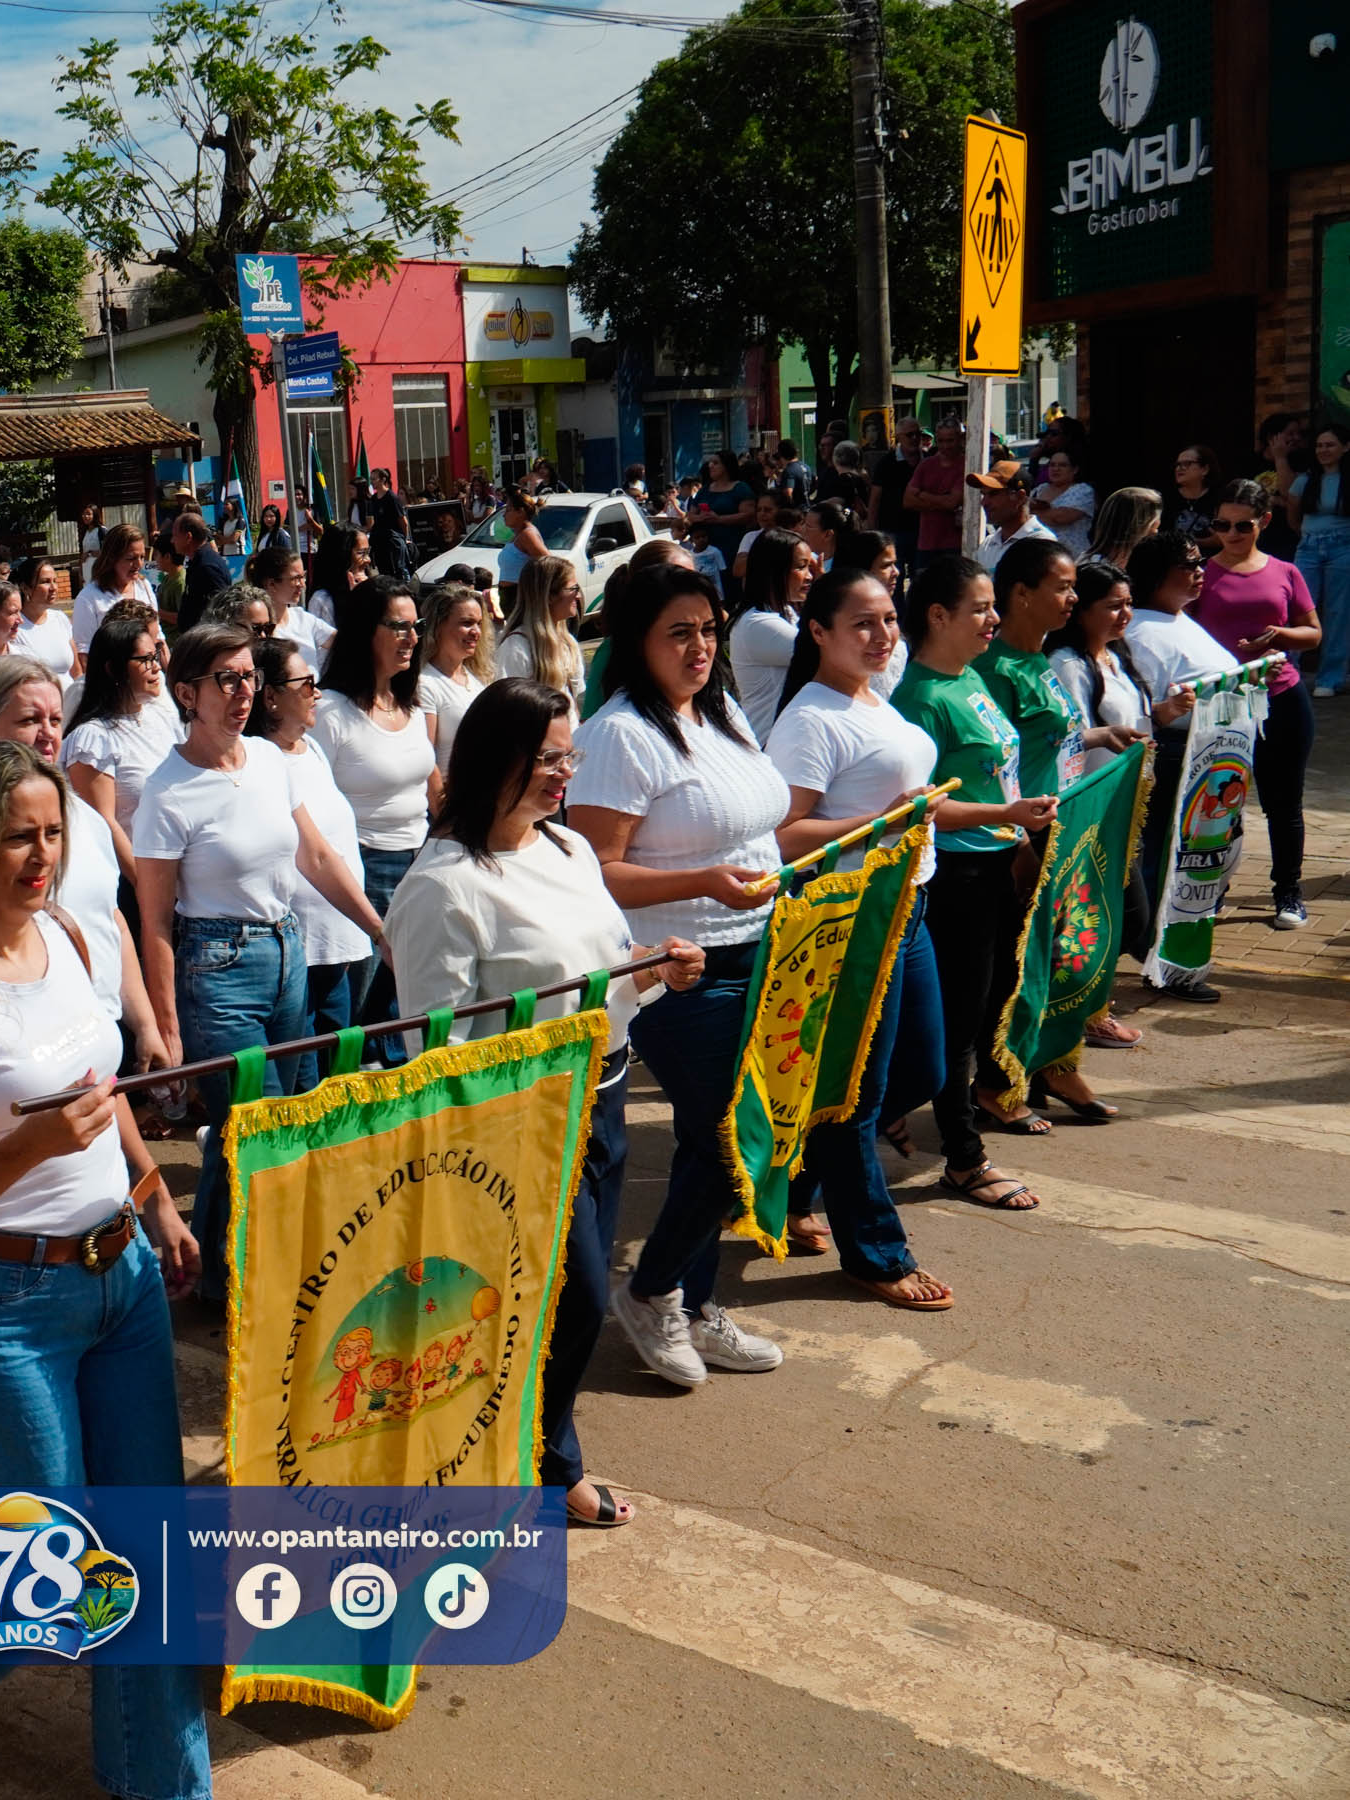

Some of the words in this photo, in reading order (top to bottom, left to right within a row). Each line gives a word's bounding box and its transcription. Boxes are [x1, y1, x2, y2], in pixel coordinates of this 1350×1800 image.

[1068, 117, 1200, 212] BAMBU
[1087, 198, 1178, 235] Gastrobar
[288, 377, 306, 386] Monte
[306, 376, 328, 385] Castelo
[789, 950, 809, 972] de
[281, 1250, 338, 1386] CENTRO
[337, 1202, 374, 1247] DE
[375, 1147, 488, 1208] EDUCAÇÃO
[276, 1414, 301, 1488] VERA
[435, 1314, 520, 1488] FIGUEIREDO
